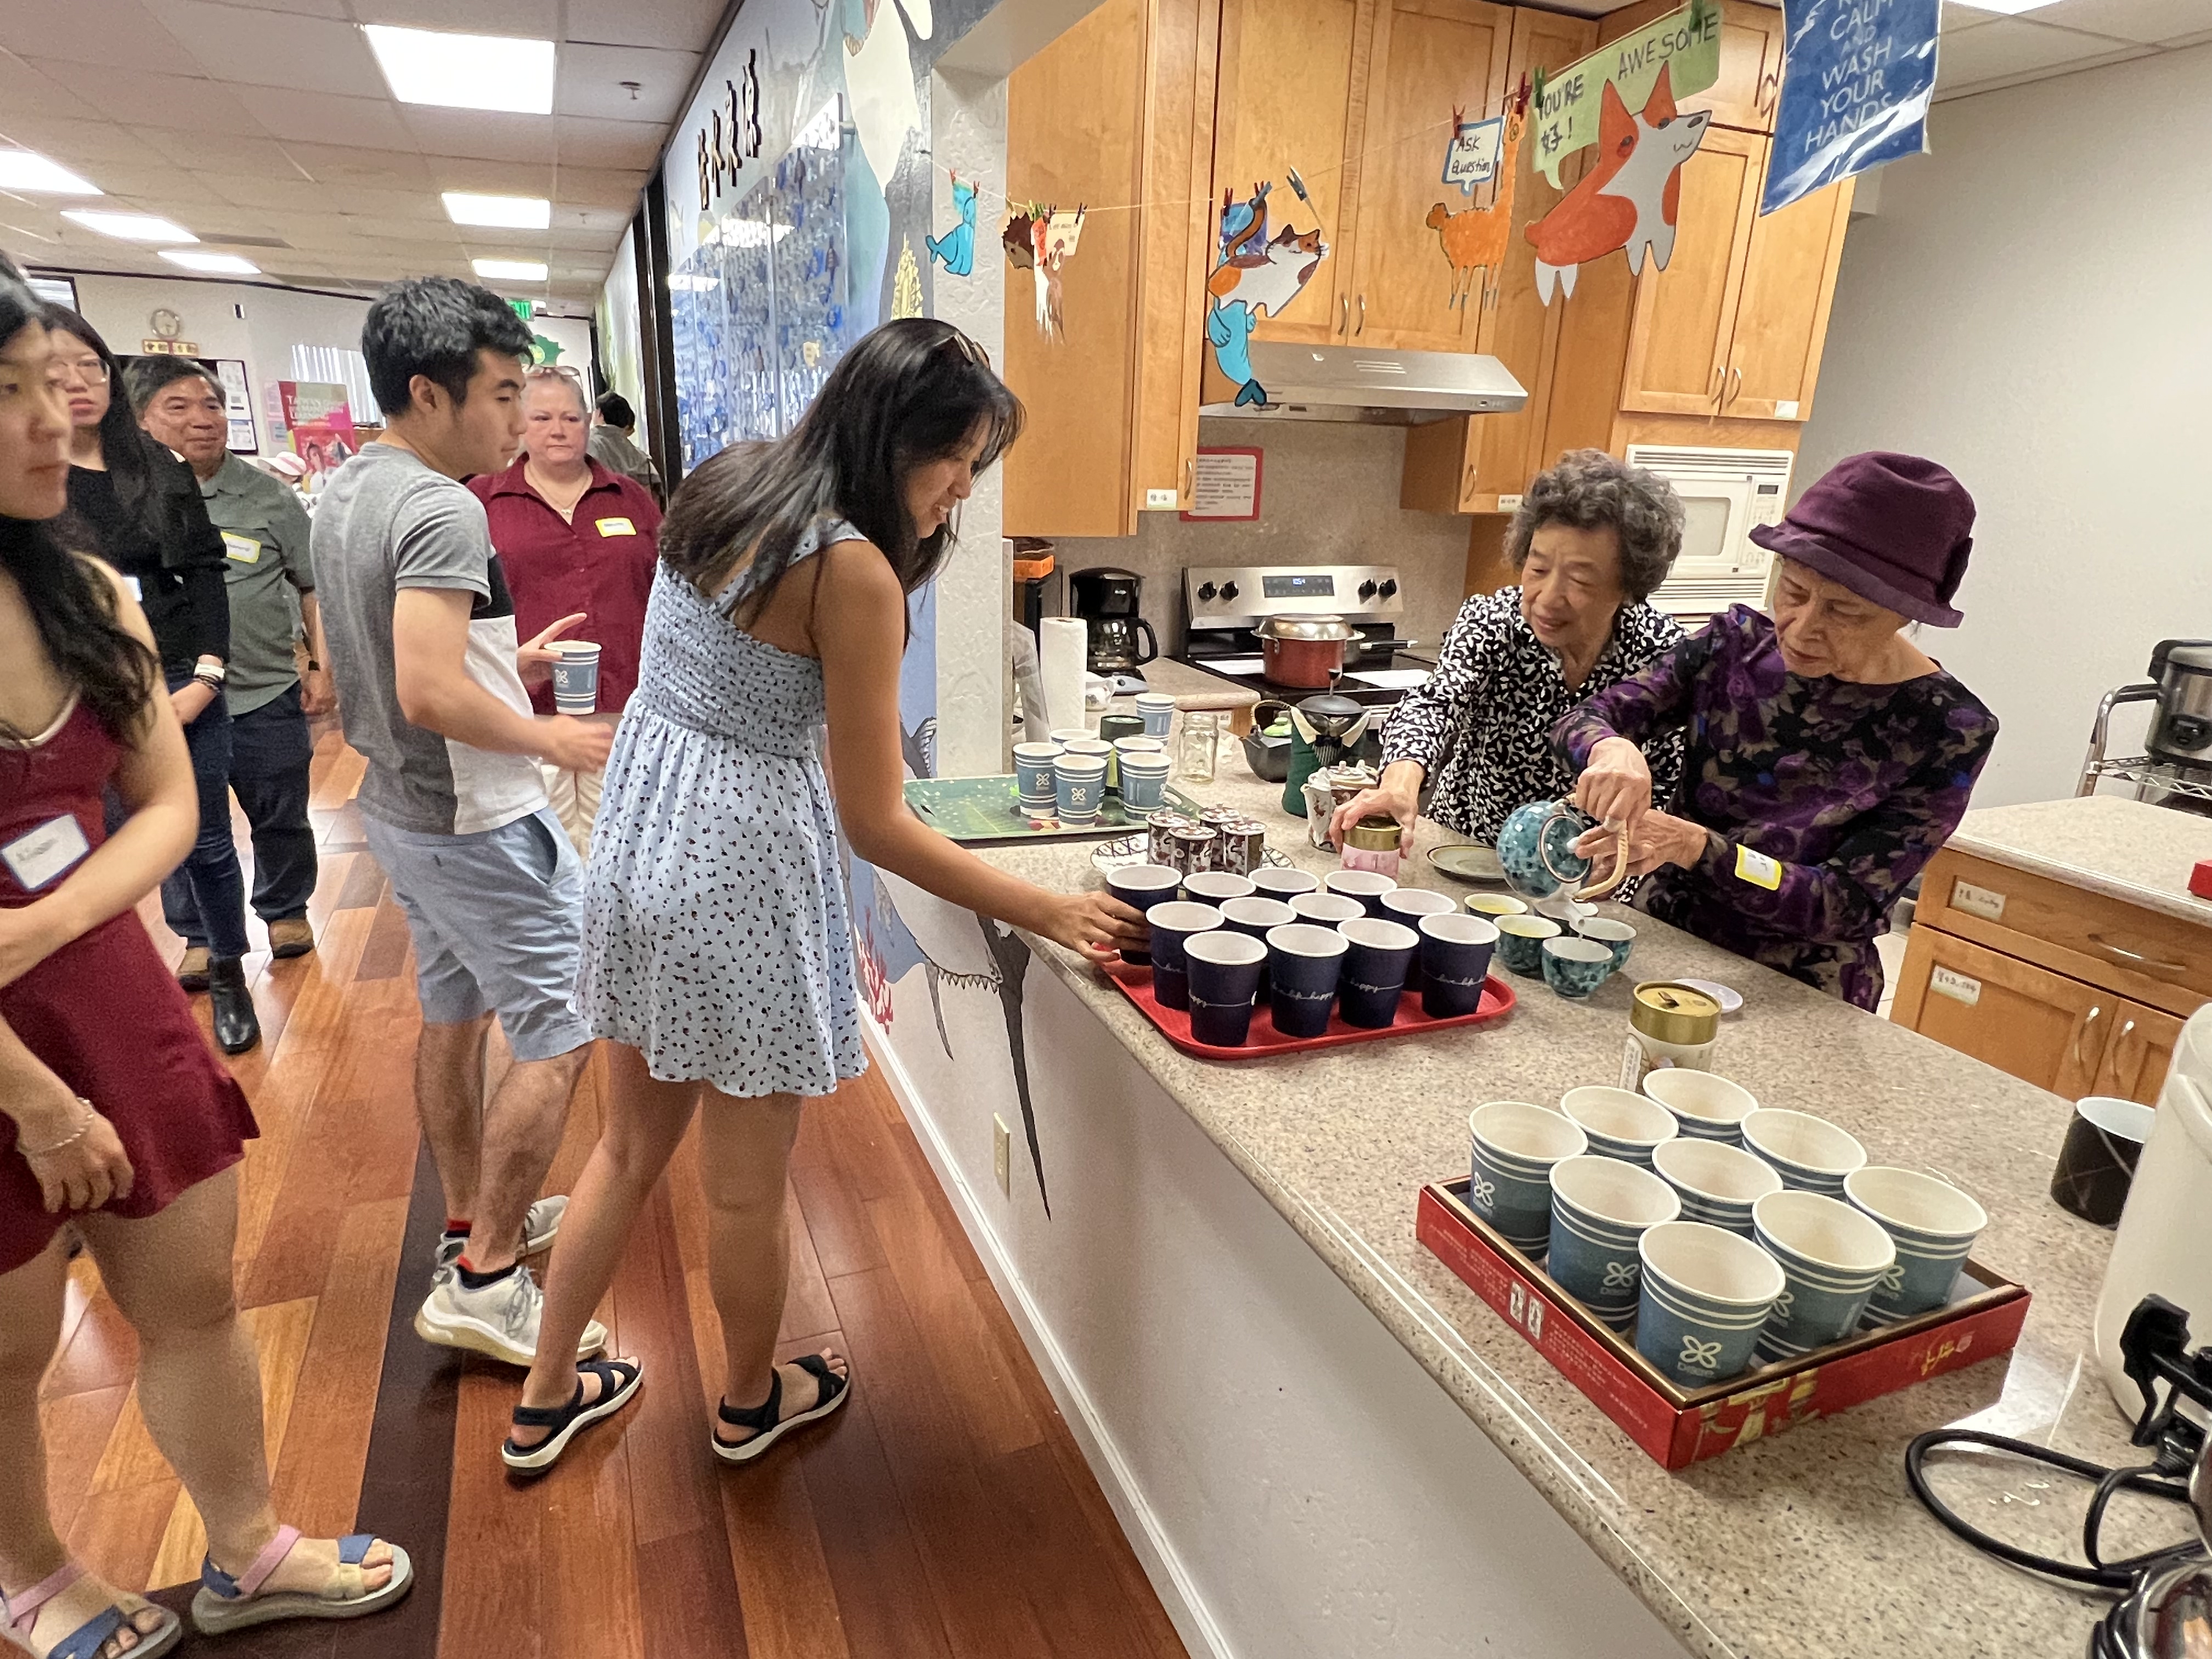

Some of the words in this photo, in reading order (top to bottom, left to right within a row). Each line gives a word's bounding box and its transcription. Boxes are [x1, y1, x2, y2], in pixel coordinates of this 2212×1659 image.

[1618, 12, 1718, 81] AWESOME
[1822, 35, 1892, 92] WASH
[1820, 69, 1884, 119] YOUR
[1455, 134, 1481, 153] ASK
